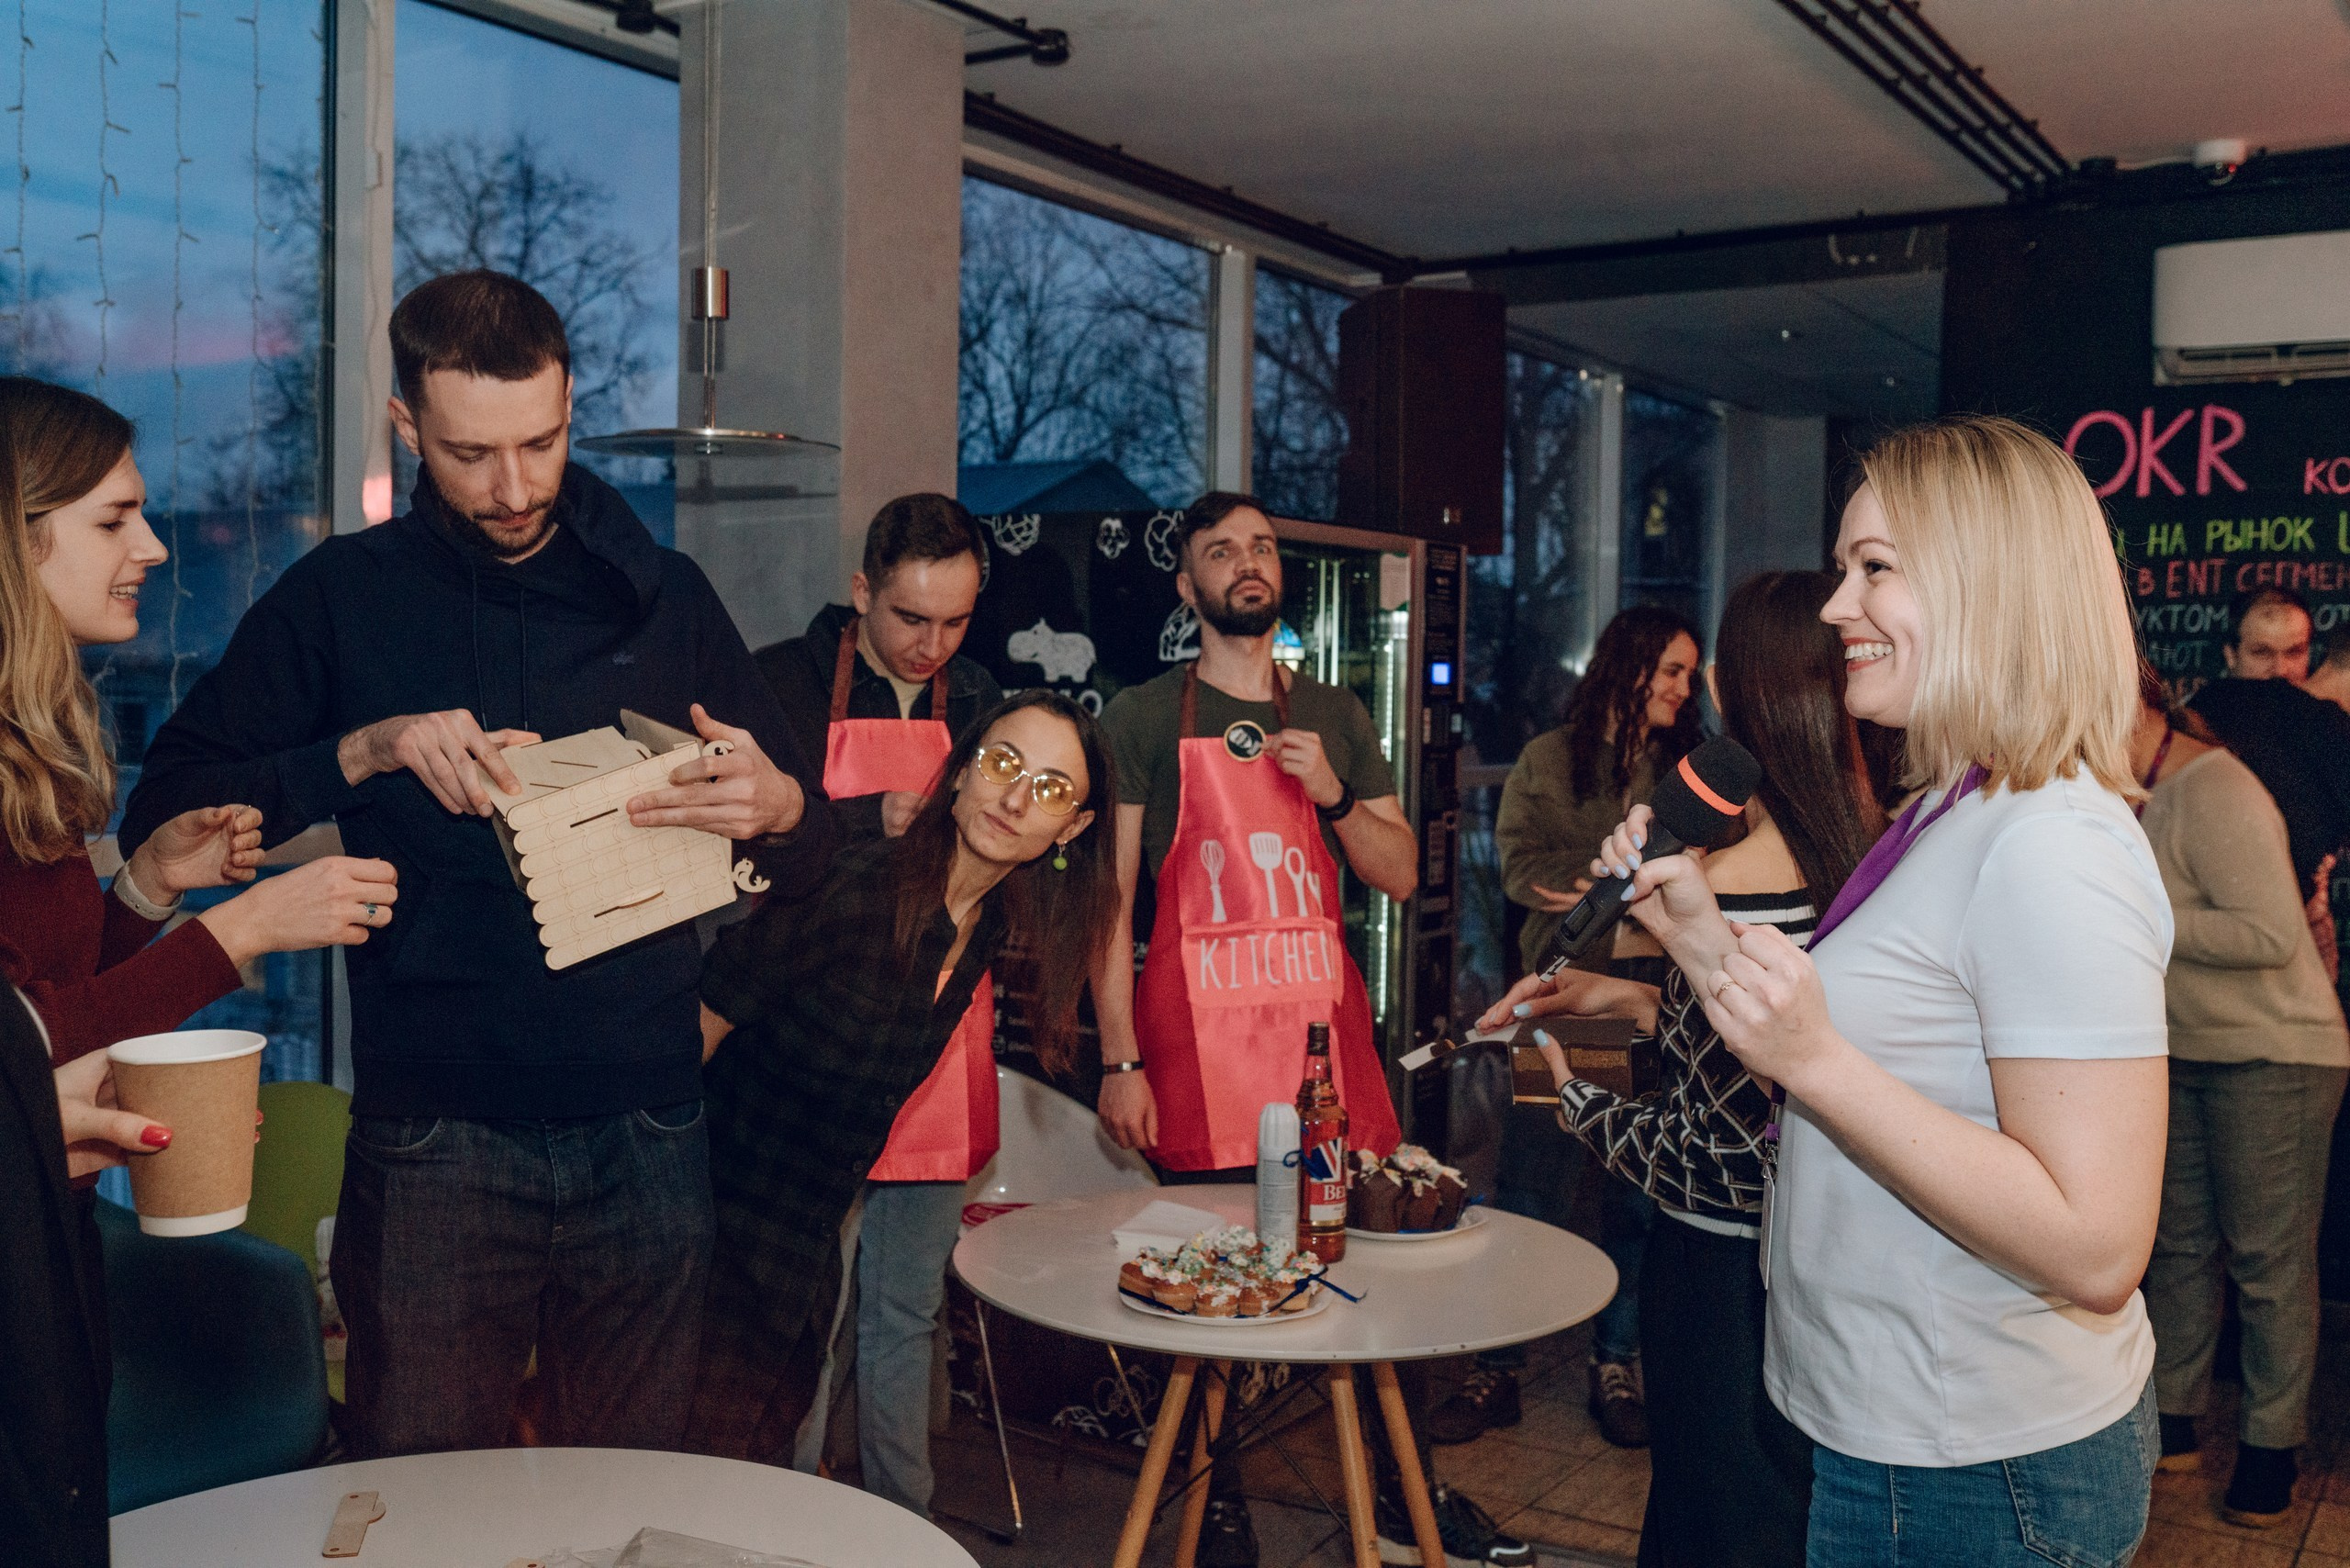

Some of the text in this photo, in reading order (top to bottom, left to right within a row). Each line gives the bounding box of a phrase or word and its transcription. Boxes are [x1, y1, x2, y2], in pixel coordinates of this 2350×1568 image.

[2065, 404, 2247, 498] OKR
[2146, 521, 2188, 557] НА
[2205, 516, 2315, 553] РЫНОК
